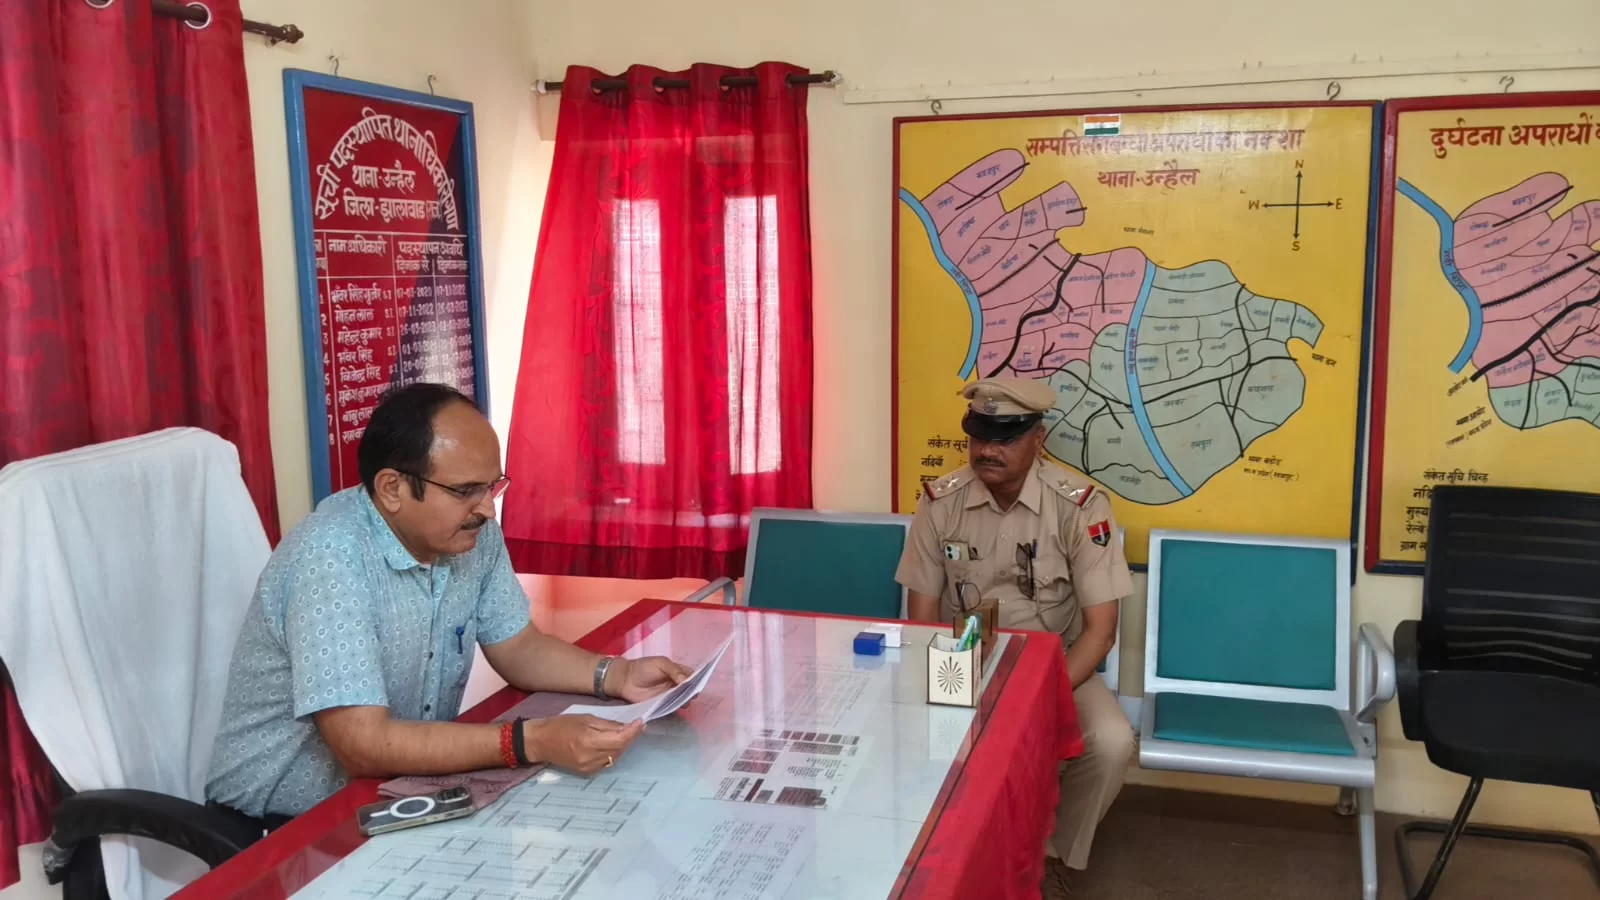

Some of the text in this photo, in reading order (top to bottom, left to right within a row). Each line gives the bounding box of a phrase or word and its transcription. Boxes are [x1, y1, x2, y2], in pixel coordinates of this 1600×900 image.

[1430, 117, 1505, 159] दुर्घटना
[1508, 112, 1593, 147] अपराधों
[1295, 159, 1305, 169] N
[1335, 197, 1344, 210] E
[1291, 240, 1301, 252] S
